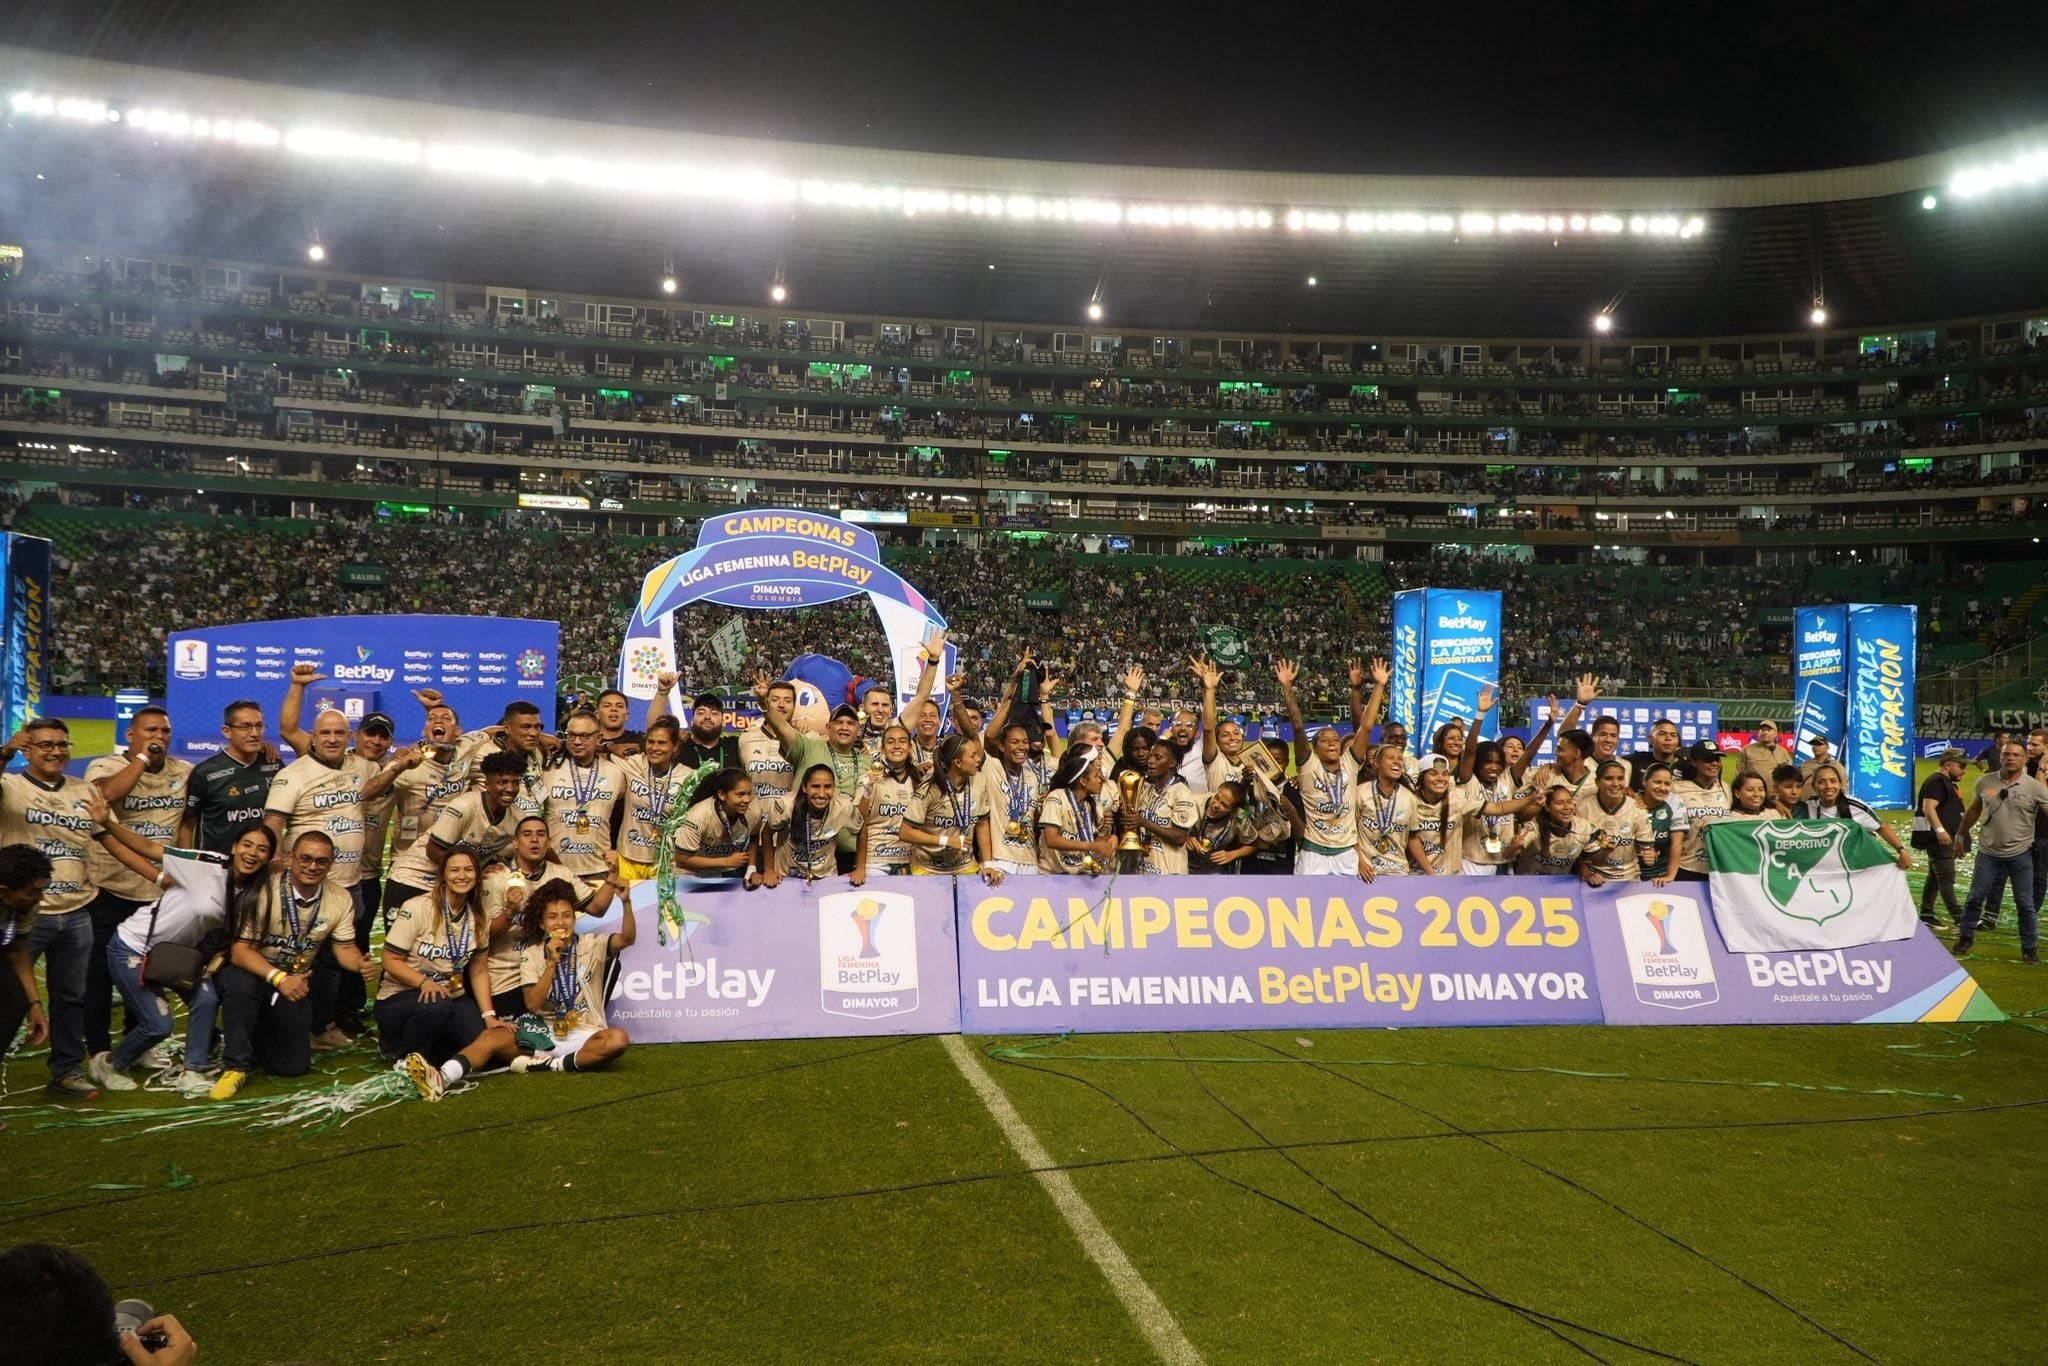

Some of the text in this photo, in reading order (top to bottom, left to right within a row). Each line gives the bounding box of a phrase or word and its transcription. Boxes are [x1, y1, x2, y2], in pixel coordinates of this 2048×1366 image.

[724, 516, 857, 547] CAMPEONAS
[679, 550, 872, 588] LIGA FEMENINA BetPlay
[351, 573, 382, 581] SALIDA
[753, 585, 801, 595] DIMAYOR
[750, 595, 803, 603] COLOMBIA
[1027, 599, 1053, 607] SALIDA
[1439, 616, 1487, 632] BetPlay
[1430, 637, 1493, 648] DESCARGA
[1805, 630, 1837, 644] BetPlay
[1431, 646, 1494, 658] LA APP Y
[1799, 649, 1841, 661] DESCARGA
[1800, 661, 1811, 670] LA
[1813, 658, 1833, 669] APP
[334, 664, 395, 682] BetPlay
[722, 711, 754, 731] Play
[551, 786, 612, 800] Wpy.co
[314, 791, 364, 809] Wplay.c
[1775, 837, 1831, 850] DEPORTIVO
[1770, 851, 1840, 904] CALI
[971, 895, 1580, 951] CAMPEONAS 2025
[838, 955, 857, 963] LIGA
[838, 969, 900, 985] BetPlay
[1645, 965, 1699, 980] BetPlay
[1745, 950, 1892, 994] BetPlay
[978, 962, 1589, 1012] LIGA FEMENINA BetPlay DIMAYOR
[1653, 990, 1702, 1000] DIMAYOR
[1774, 992, 1820, 1003] Apuéstale
[1831, 993, 1840, 1002] tu
[1842, 992, 1874, 1003] pasión
[842, 996, 898, 1009] DIMAYOR
[613, 1008, 672, 1020] Apuéstale
[686, 1008, 697, 1018] tu
[701, 1007, 739, 1019] pasión
